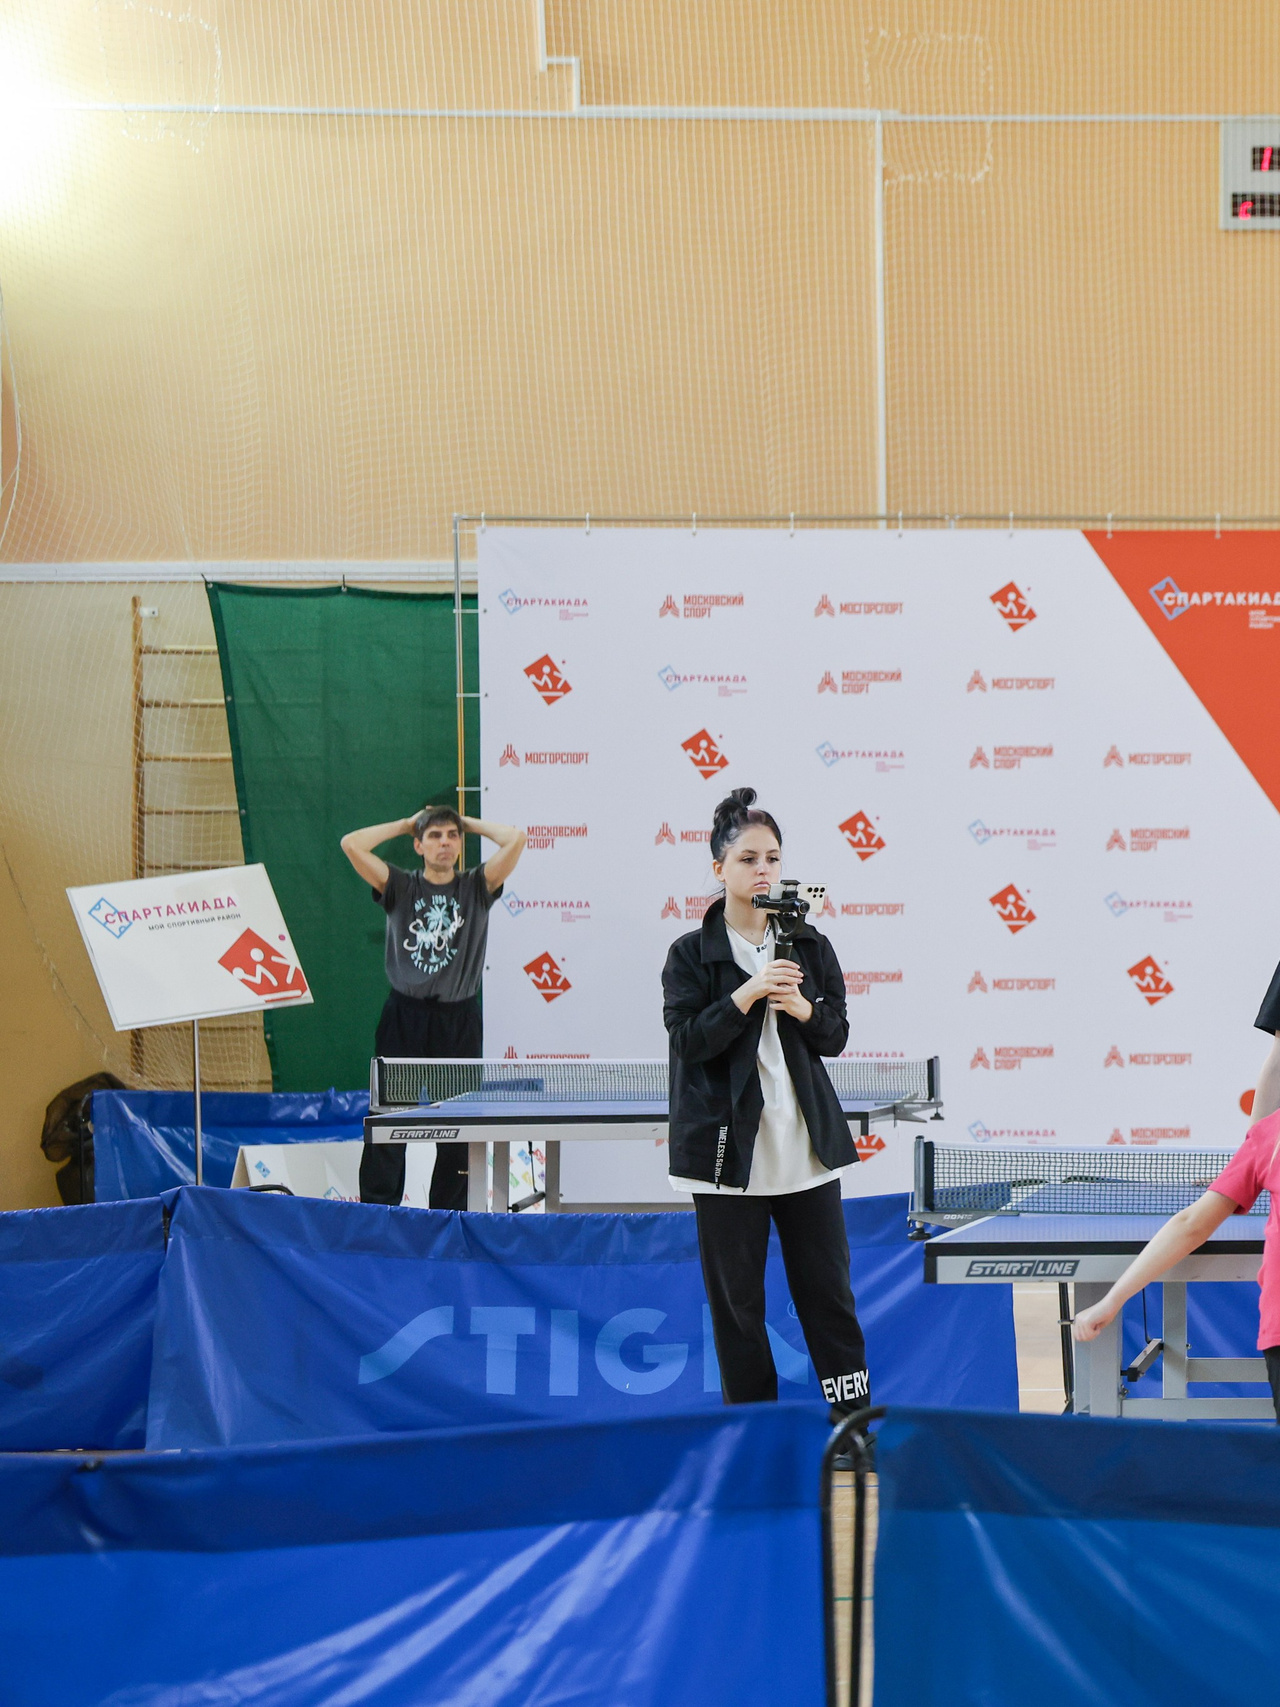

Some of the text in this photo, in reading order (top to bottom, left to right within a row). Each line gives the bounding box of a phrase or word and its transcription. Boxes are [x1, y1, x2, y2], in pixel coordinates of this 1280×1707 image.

[507, 597, 588, 607] СПАРТАКИАДА
[683, 592, 744, 606] МОСКОВСКИЙ
[683, 607, 712, 618] СПОРТ
[840, 602, 903, 615] МОСГОРСПОРТ
[666, 674, 747, 683] СПАРТАКИАДА
[842, 669, 902, 682] МОСКОВСКИЙ
[842, 683, 870, 694] СПОРТ
[525, 752, 589, 765] МОСГОРСПОРТ
[824, 750, 905, 759] СПАРТАКИАДА
[527, 823, 588, 837] МОСКОВСКИЙ
[527, 838, 555, 850] СПОРТ
[104, 896, 237, 925] СПАРТАКИАДА
[509, 900, 591, 909] СПАРТАКИАДА
[841, 903, 904, 916] МОСГОРСПОРТ
[167, 916, 216, 929] СПОРТИВНЫЙ
[217, 913, 241, 921] РАЙОН
[391, 1130, 457, 1138] START LINE
[717, 1125, 728, 1158] TIMELESS
[969, 1262, 1075, 1275] START LINE
[821, 1368, 869, 1403] EVERY
